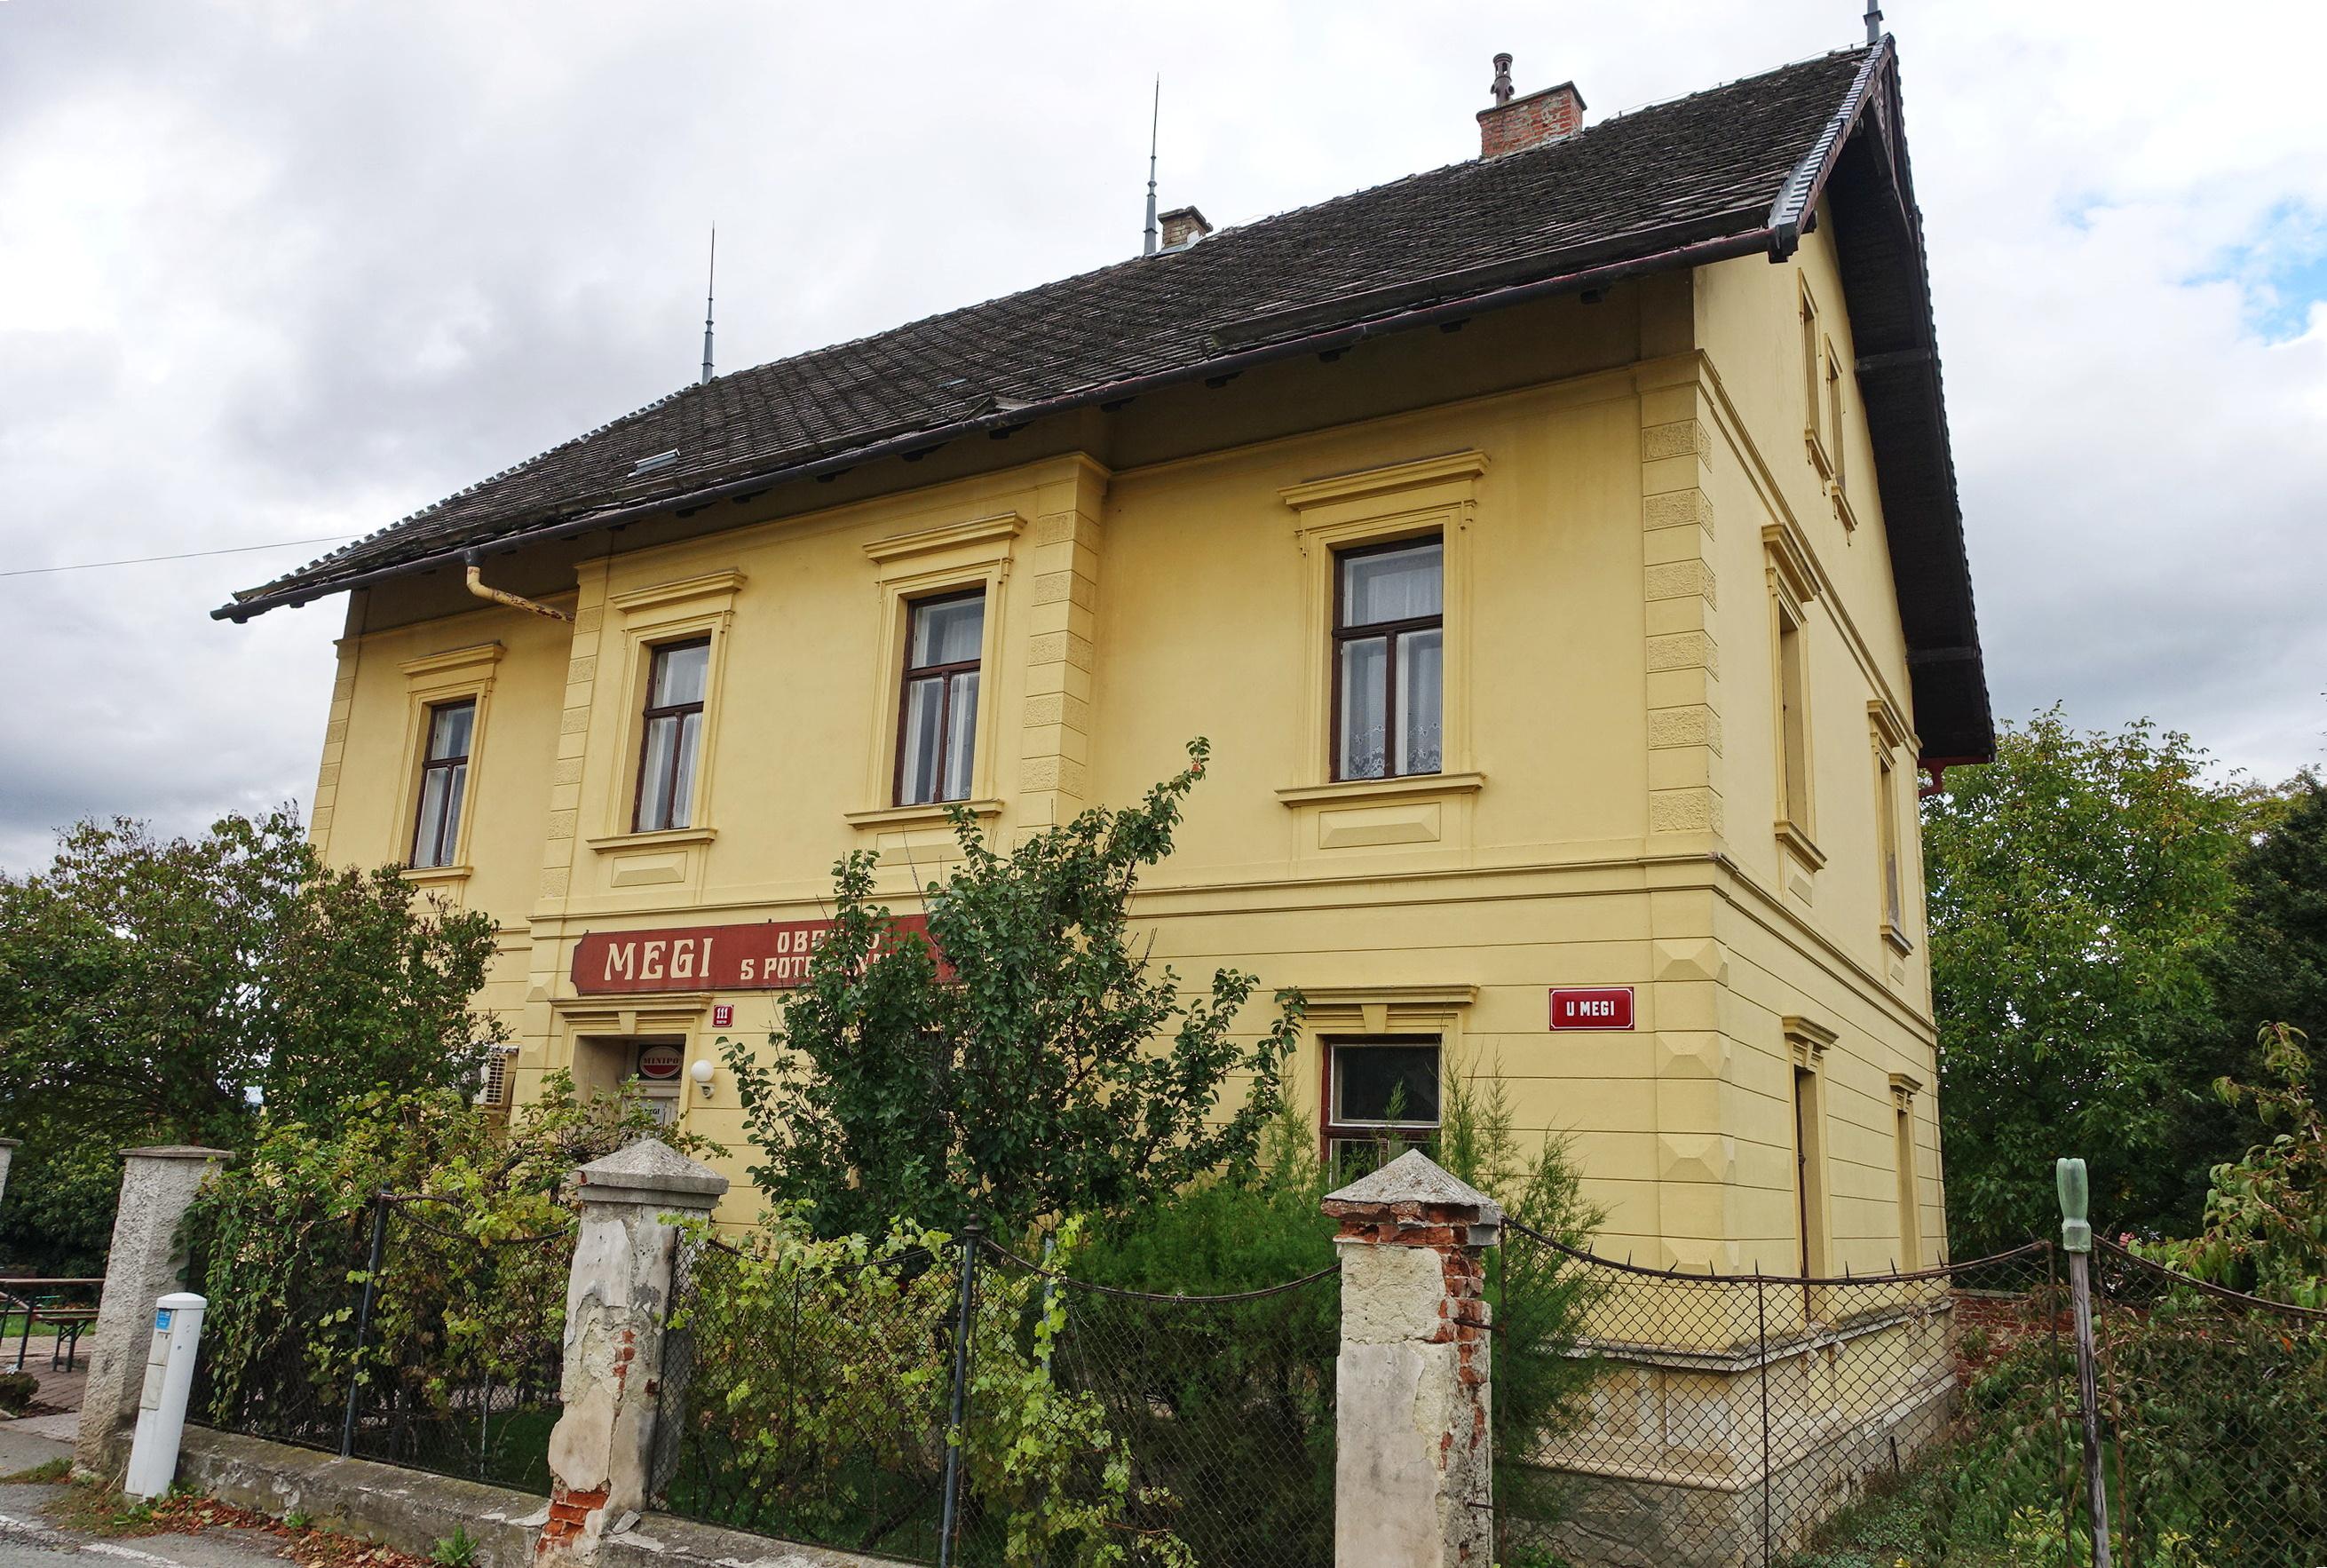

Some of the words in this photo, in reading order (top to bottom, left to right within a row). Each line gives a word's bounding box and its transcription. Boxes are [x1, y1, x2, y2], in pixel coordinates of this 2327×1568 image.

[604, 938, 714, 981] MEGI
[740, 959, 755, 979] S
[716, 1008, 728, 1019] 111
[1566, 1001, 1575, 1017] U
[1579, 1001, 1615, 1017] MEGI
